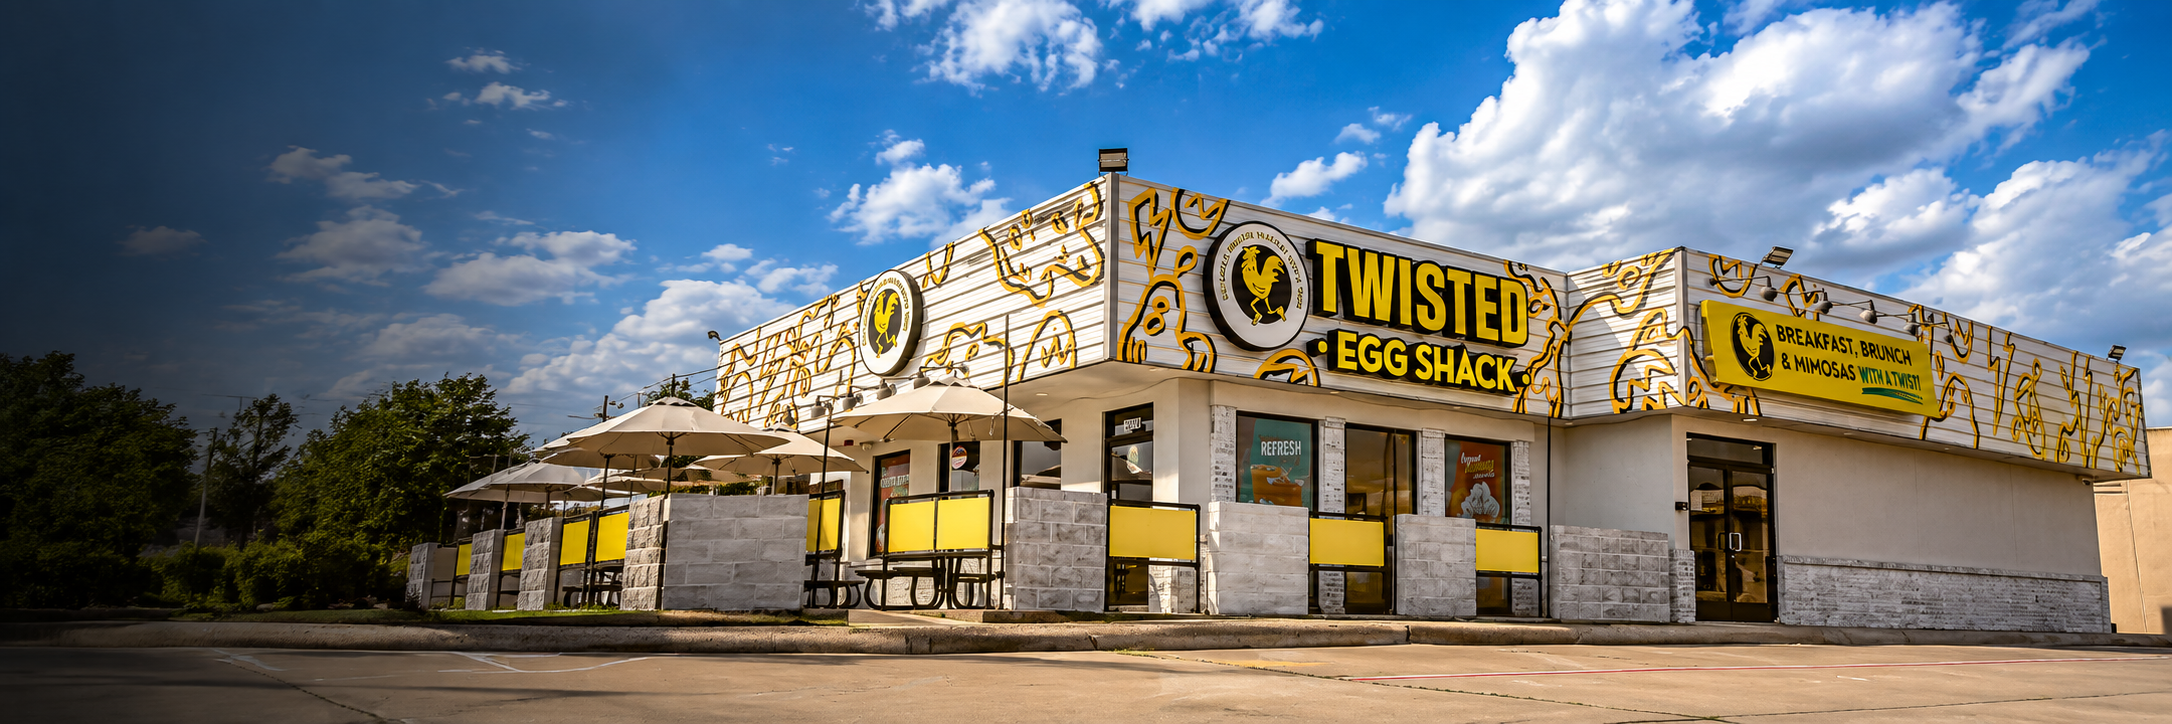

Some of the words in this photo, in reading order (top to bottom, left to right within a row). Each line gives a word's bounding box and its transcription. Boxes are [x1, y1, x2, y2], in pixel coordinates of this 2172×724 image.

[1313, 240, 1529, 346] TWISTED
[1337, 331, 1409, 378] EGG
[1415, 343, 1518, 394] SHACK
[1775, 323, 1859, 359] BREAKFAST,
[1859, 340, 1913, 367] BRUNCH
[1781, 352, 1792, 371] &
[1794, 354, 1857, 382] MIMOSAS
[1857, 365, 1885, 385] WITH
[1885, 370, 1893, 386] A
[1891, 371, 1922, 391] TWIST!
[1260, 440, 1302, 456] REFRESH
